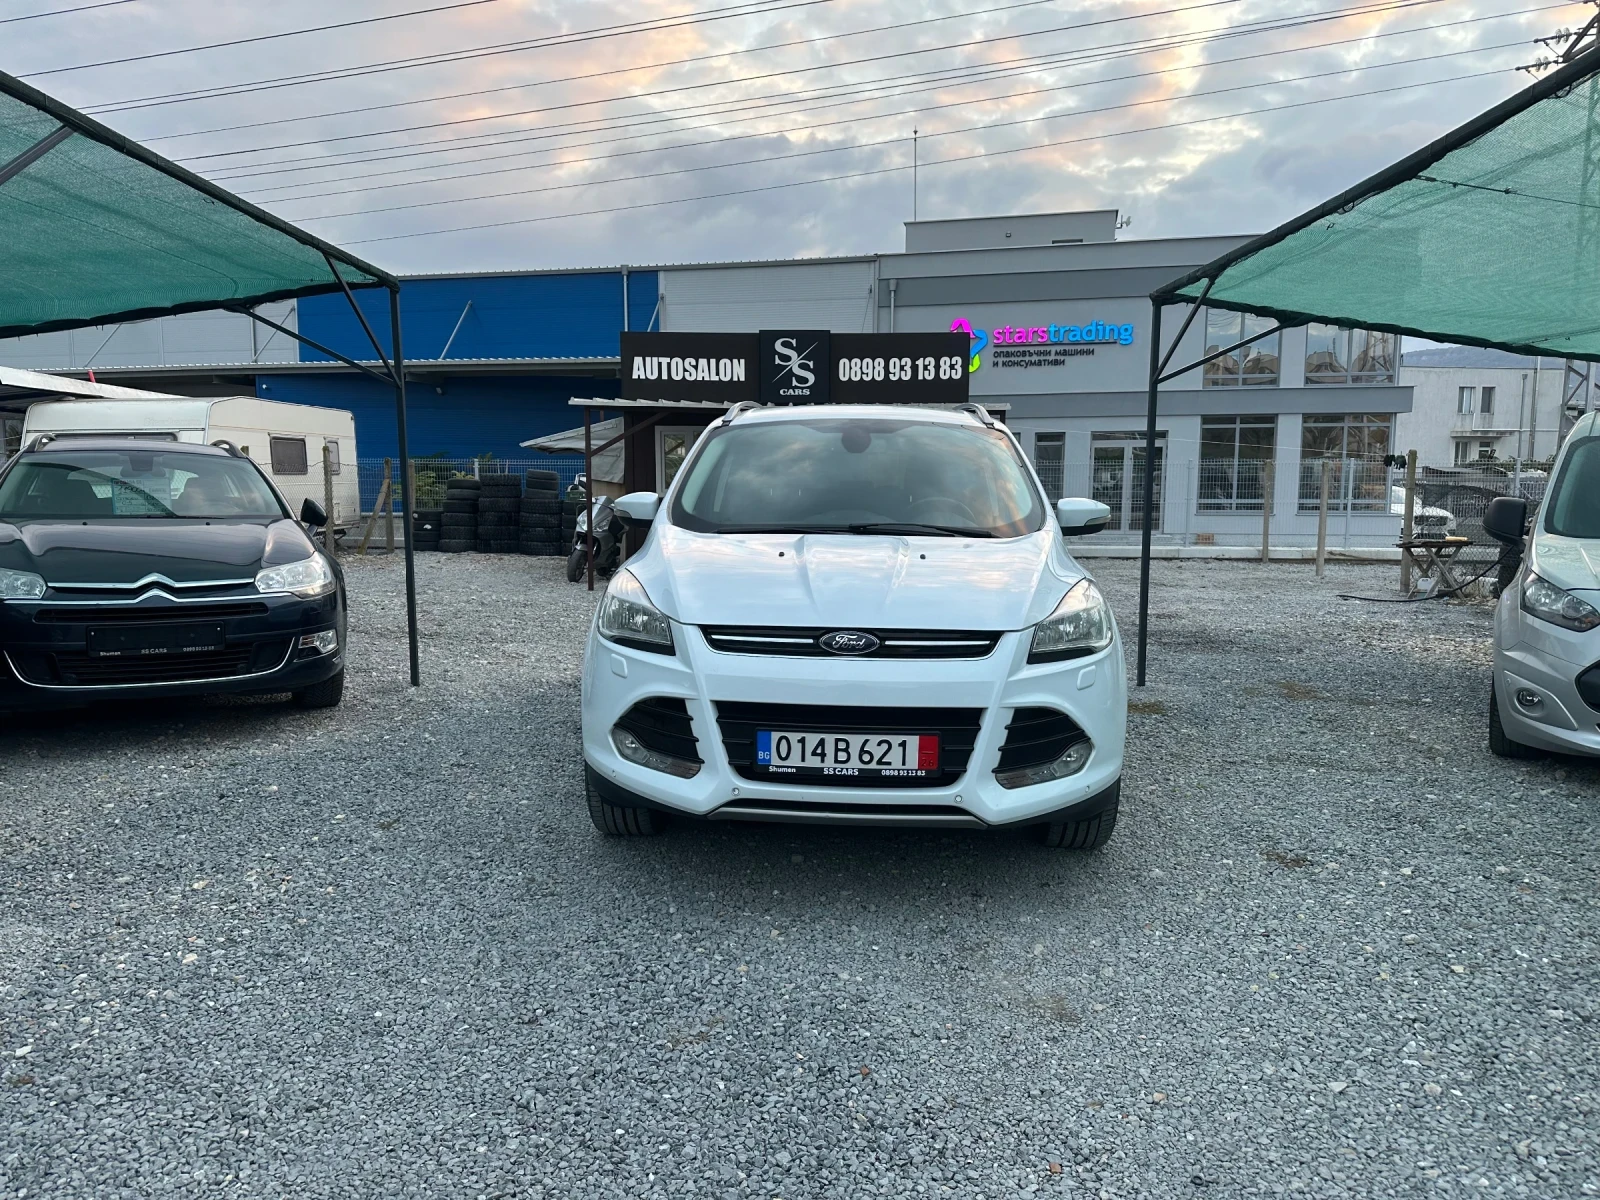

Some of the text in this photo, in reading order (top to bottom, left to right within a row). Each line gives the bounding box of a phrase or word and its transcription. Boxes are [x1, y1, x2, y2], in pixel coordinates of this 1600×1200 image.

[993, 320, 1134, 345] starstrading
[993, 347, 1095, 359] опаковъчни машини
[631, 356, 746, 382] AUTOSALON
[838, 355, 963, 382] 0898 93 13 83
[1001, 359, 1066, 369] консумативи
[779, 388, 811, 396] CARS
[832, 634, 866, 649] Ford
[758, 751, 770, 760] BG
[768, 765, 797, 773] Shumen
